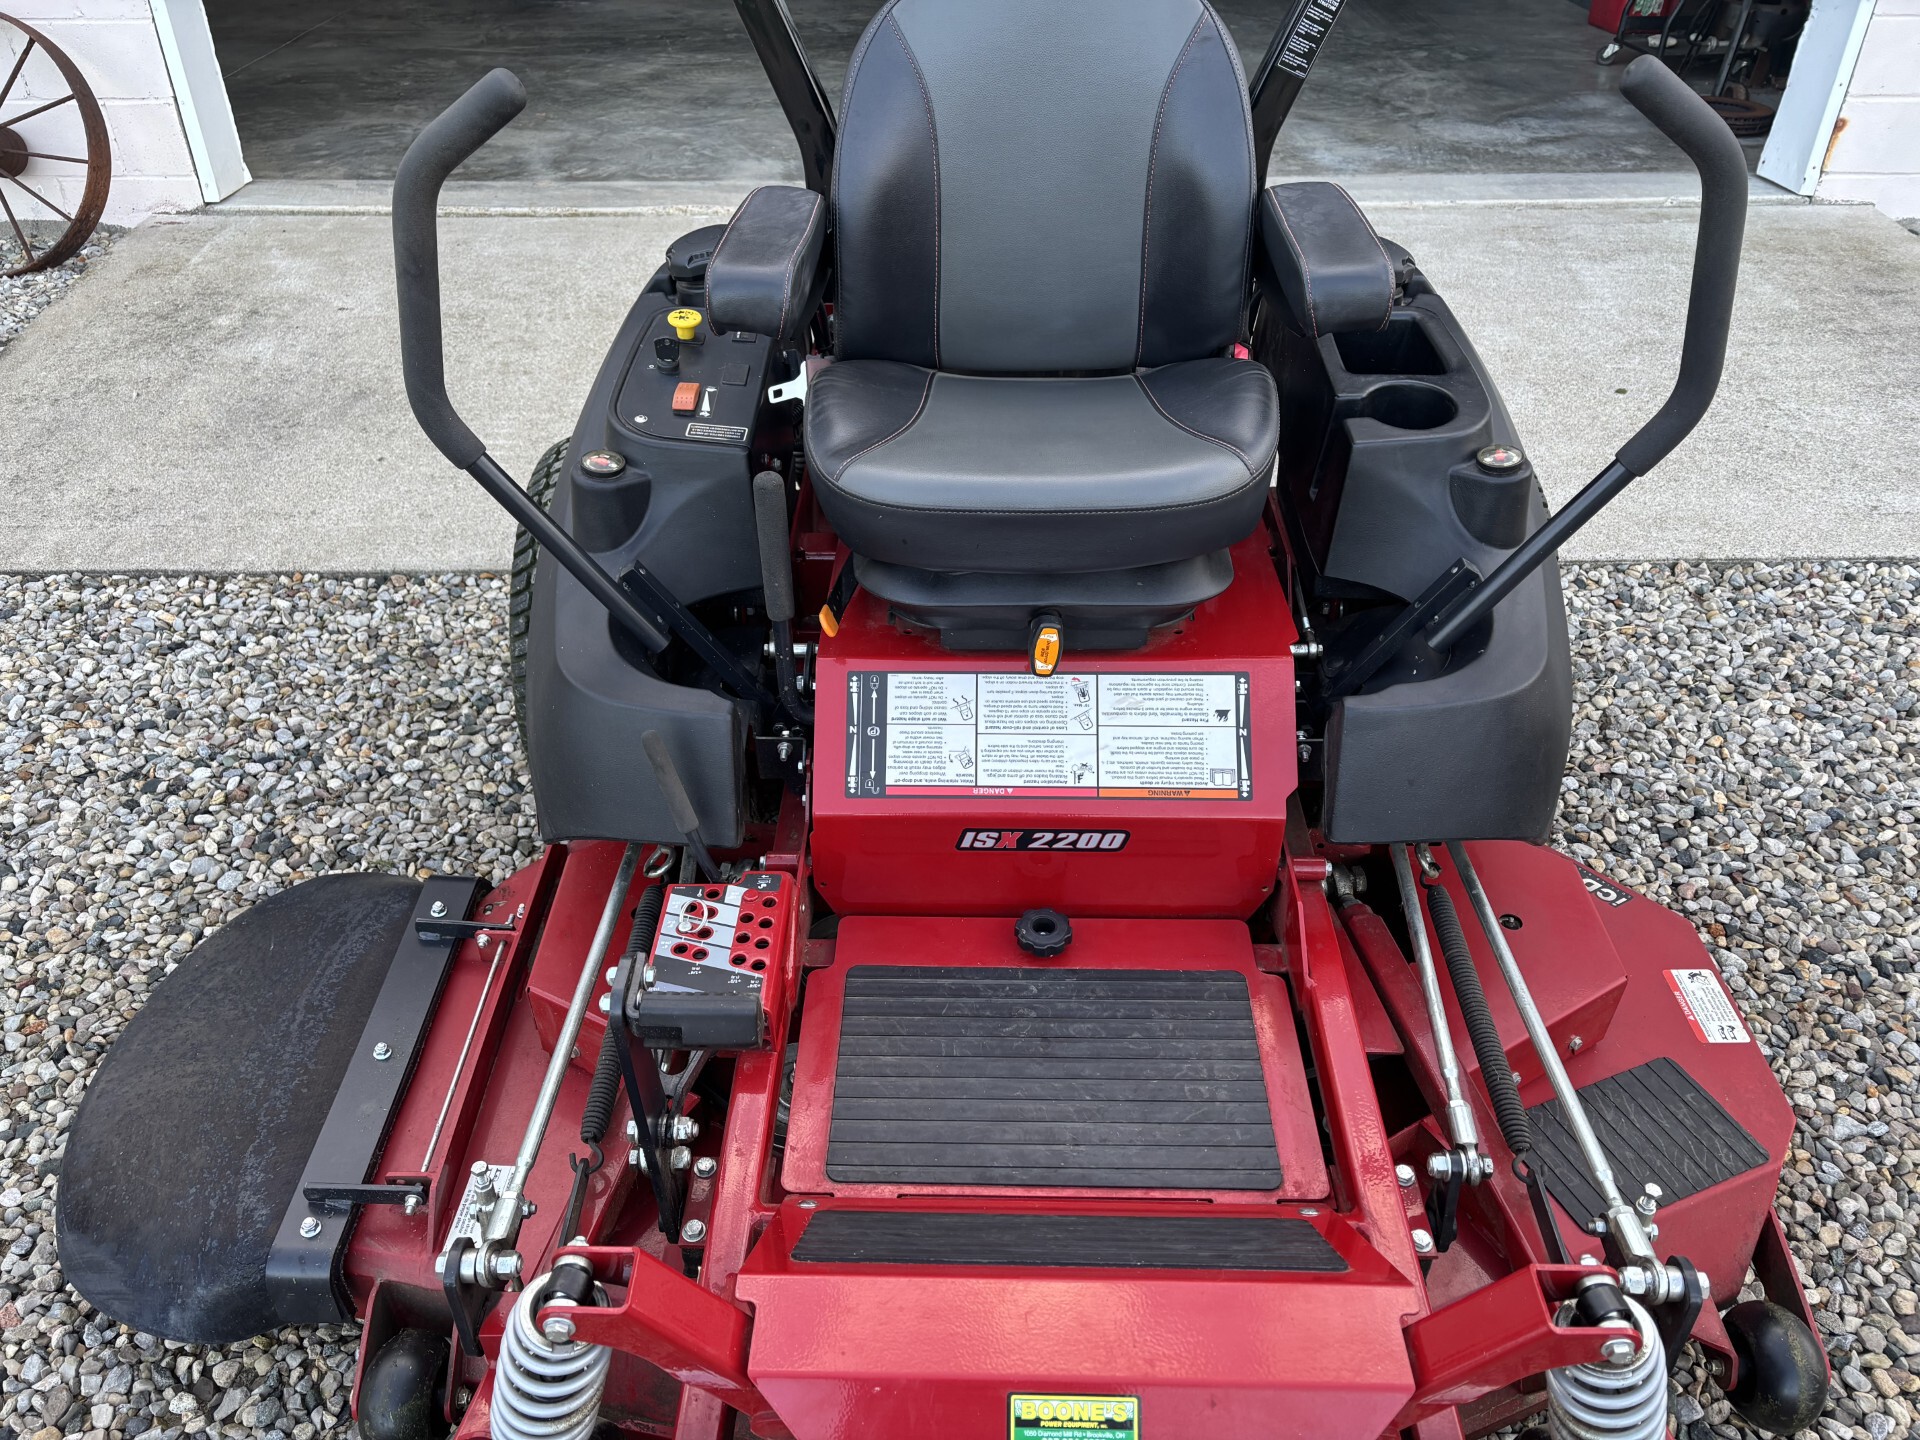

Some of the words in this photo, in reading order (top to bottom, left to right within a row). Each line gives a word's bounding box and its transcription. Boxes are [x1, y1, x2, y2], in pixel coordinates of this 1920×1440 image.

[960, 832, 1023, 848] ISX
[1027, 832, 1126, 849] 2200
[1674, 991, 1691, 1016] DANGER
[1021, 1402, 1127, 1422] BOONE'S
